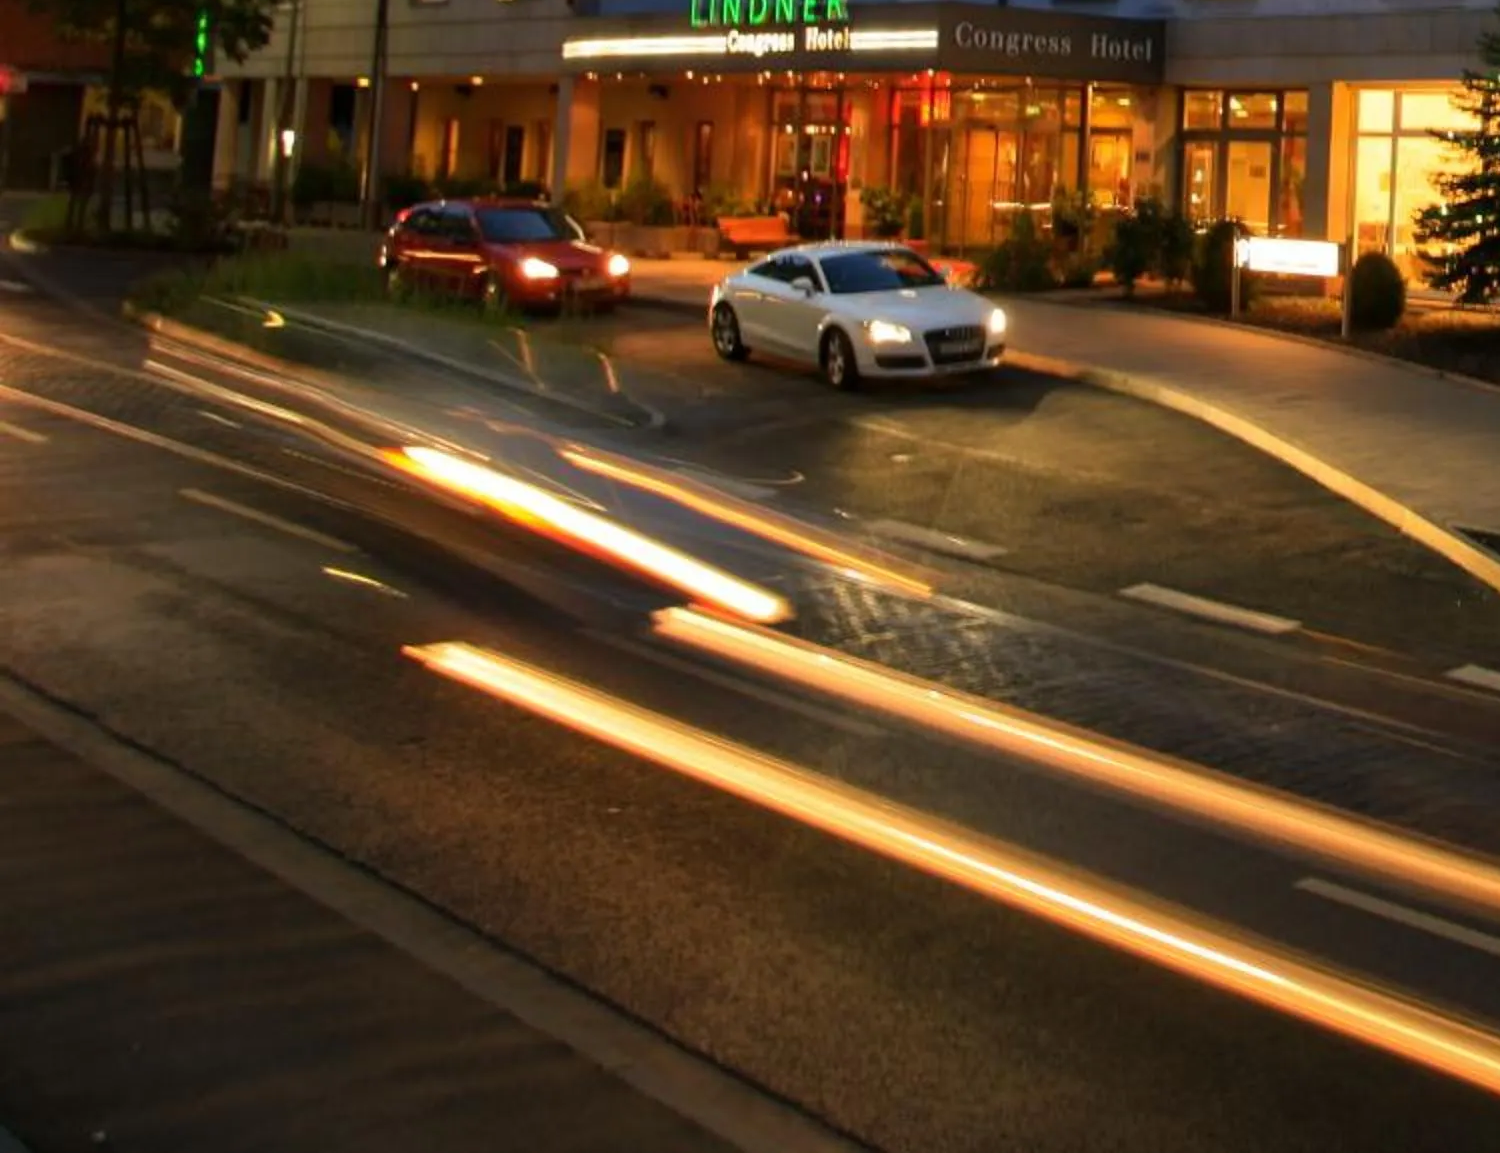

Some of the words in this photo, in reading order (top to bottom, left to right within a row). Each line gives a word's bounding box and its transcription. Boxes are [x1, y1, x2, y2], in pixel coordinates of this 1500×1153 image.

[727, 29, 795, 57] Congress
[805, 26, 849, 51] Hotel
[955, 21, 1073, 57] Congress
[1091, 32, 1153, 62] Hotel
